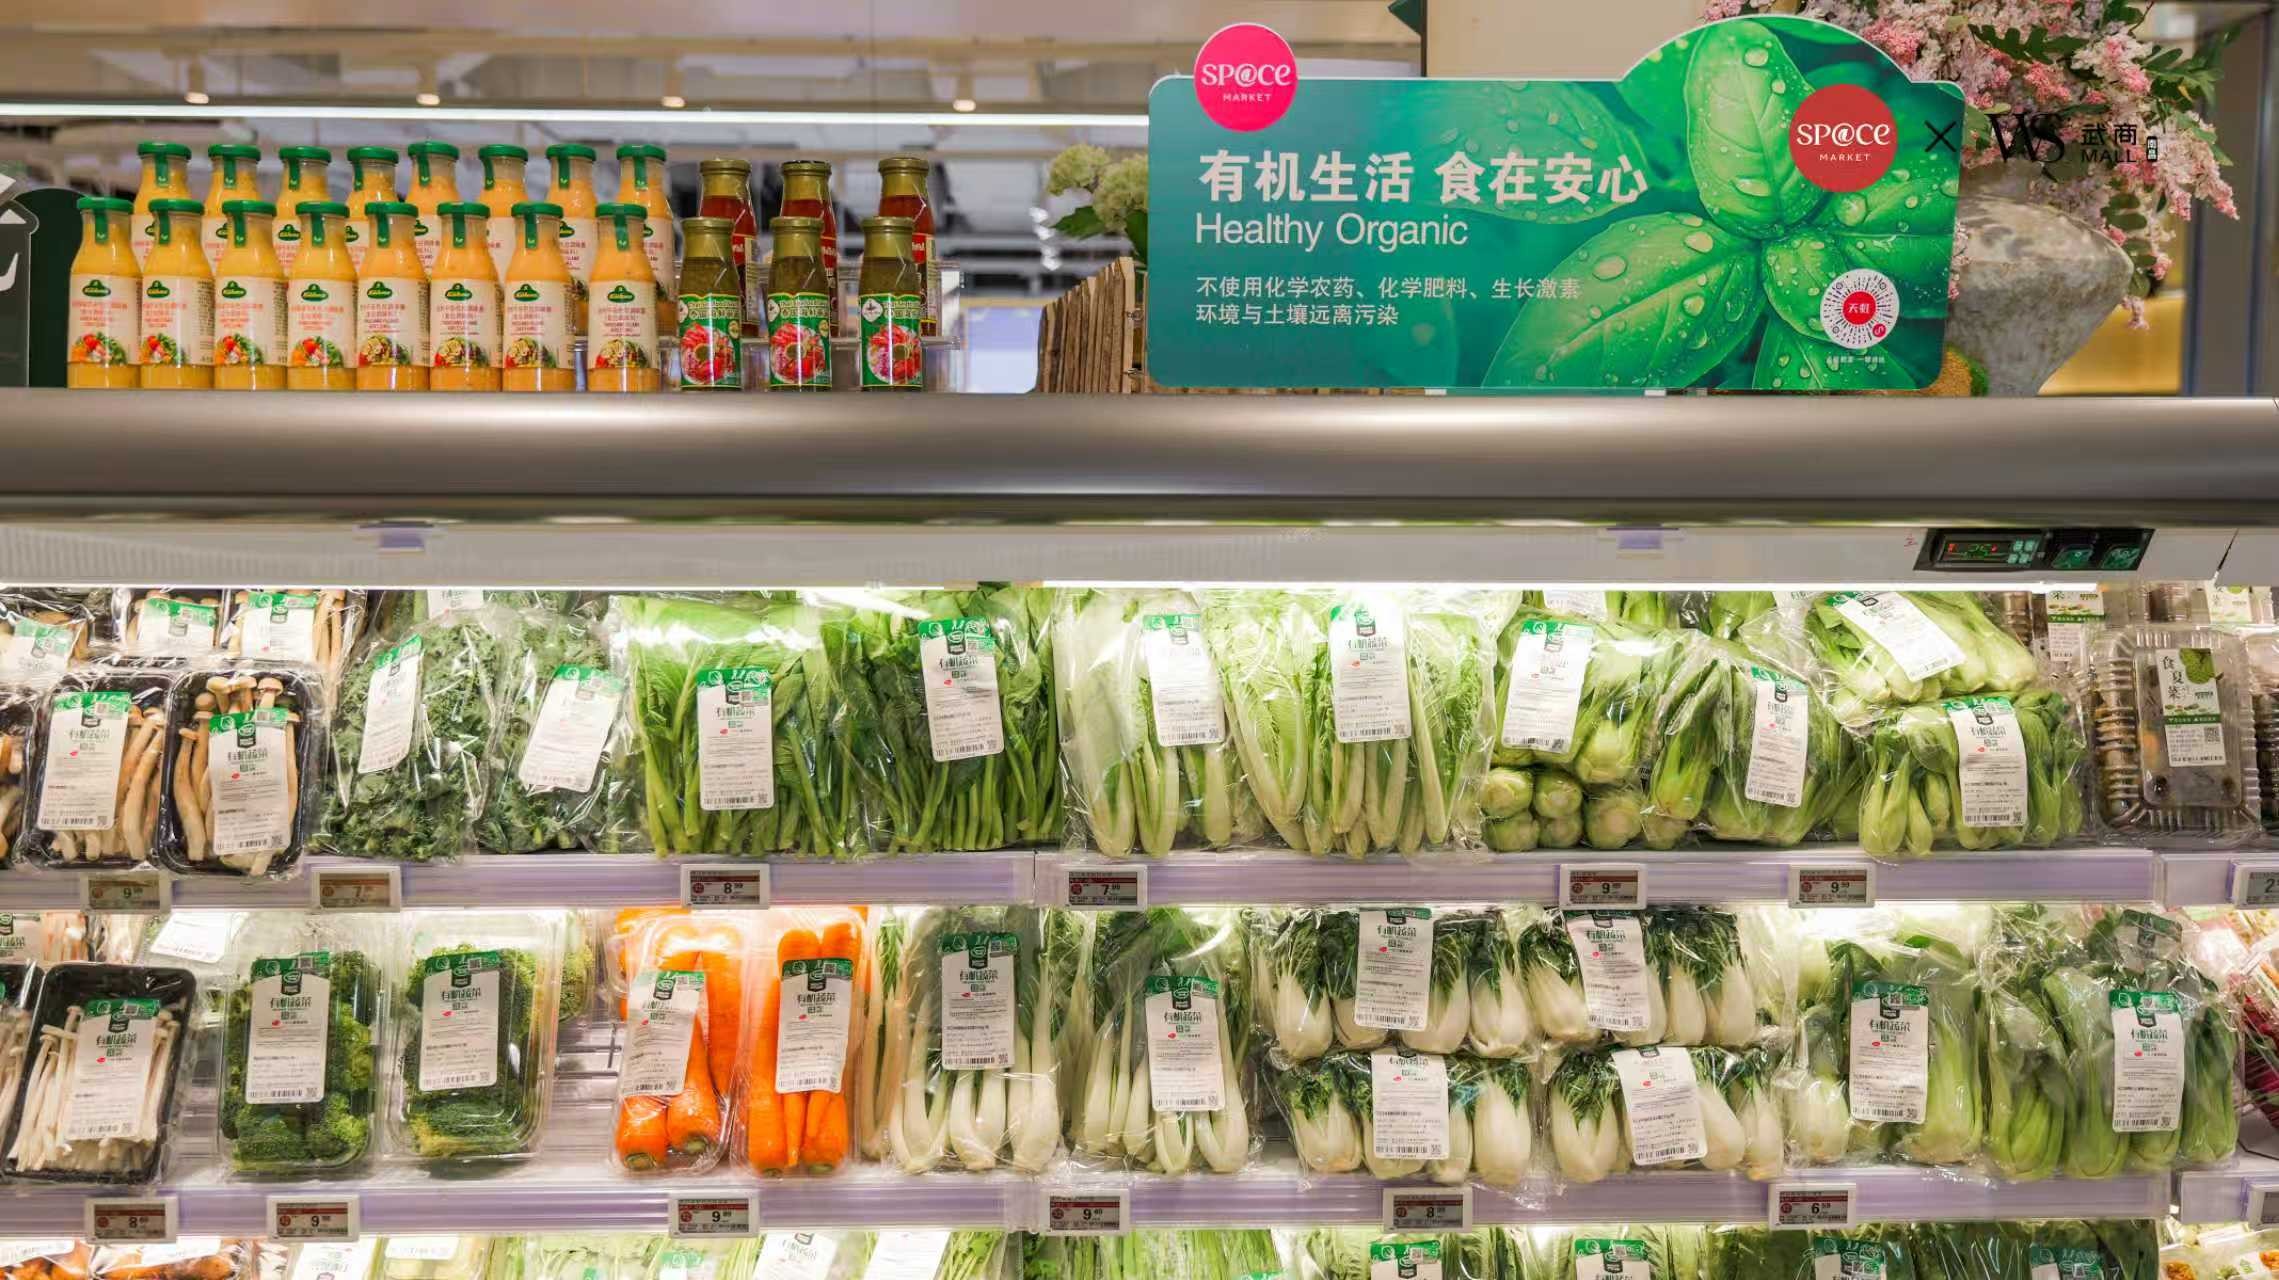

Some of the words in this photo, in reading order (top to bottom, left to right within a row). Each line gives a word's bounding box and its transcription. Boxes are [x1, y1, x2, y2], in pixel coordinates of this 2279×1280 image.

[1222, 93, 1272, 102] MARKET
[2080, 123, 2138, 147] 武商
[1818, 153, 1872, 162] MARKET
[2080, 149, 2138, 163] MALL
[1199, 149, 1414, 204] 有机生活
[1434, 150, 1649, 206] 食在安心
[1195, 212, 1324, 253] Healthy
[1336, 212, 1469, 253] Organic
[1196, 275, 1583, 300] 不使用化学农药、化学肥料、生长激素
[1196, 303, 1399, 326] 环境与土壤远离污染
